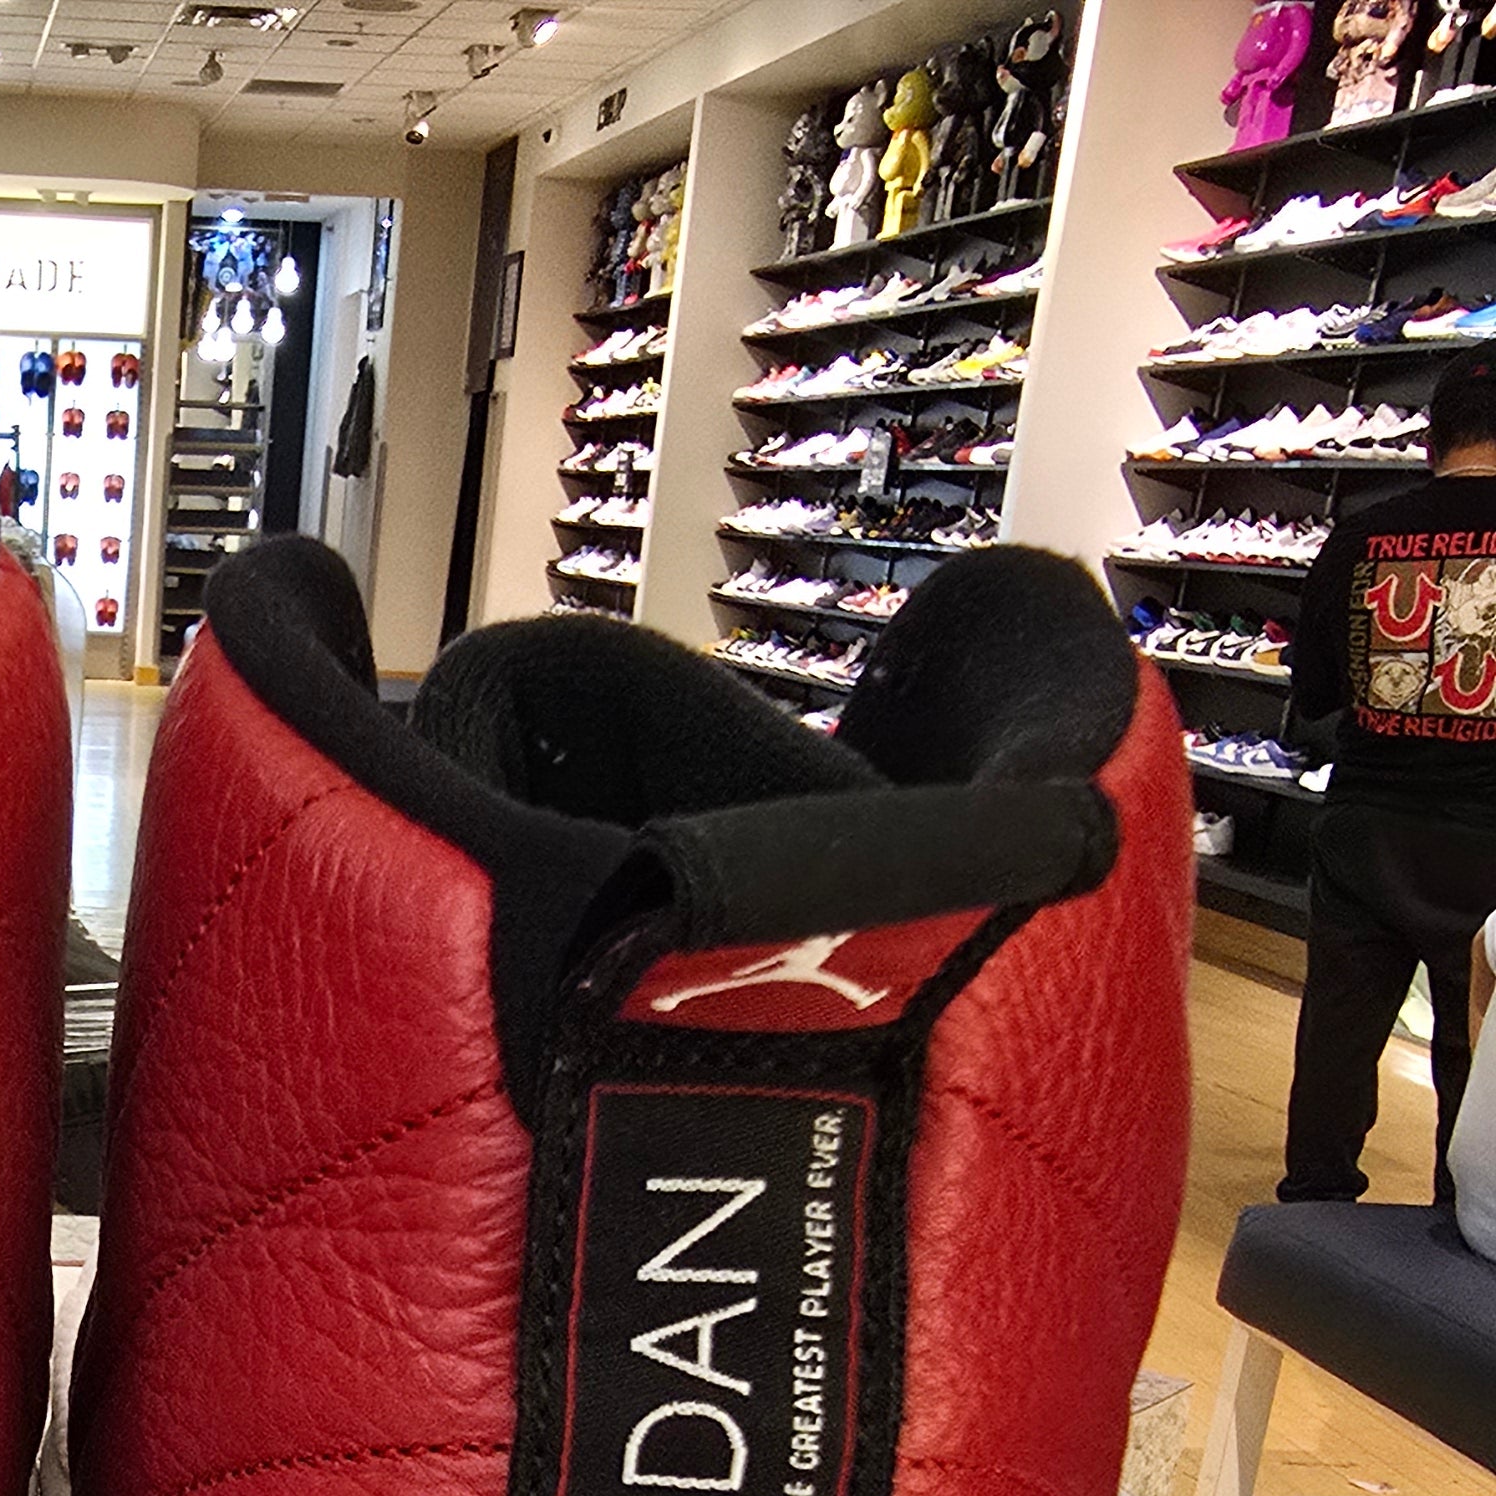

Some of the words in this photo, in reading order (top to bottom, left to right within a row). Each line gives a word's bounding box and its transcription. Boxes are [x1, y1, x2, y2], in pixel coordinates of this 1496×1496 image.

[1367, 533, 1429, 559] TRUE
[799, 1200, 836, 1317] PLAYER
[788, 1328, 826, 1470] GREATEST
